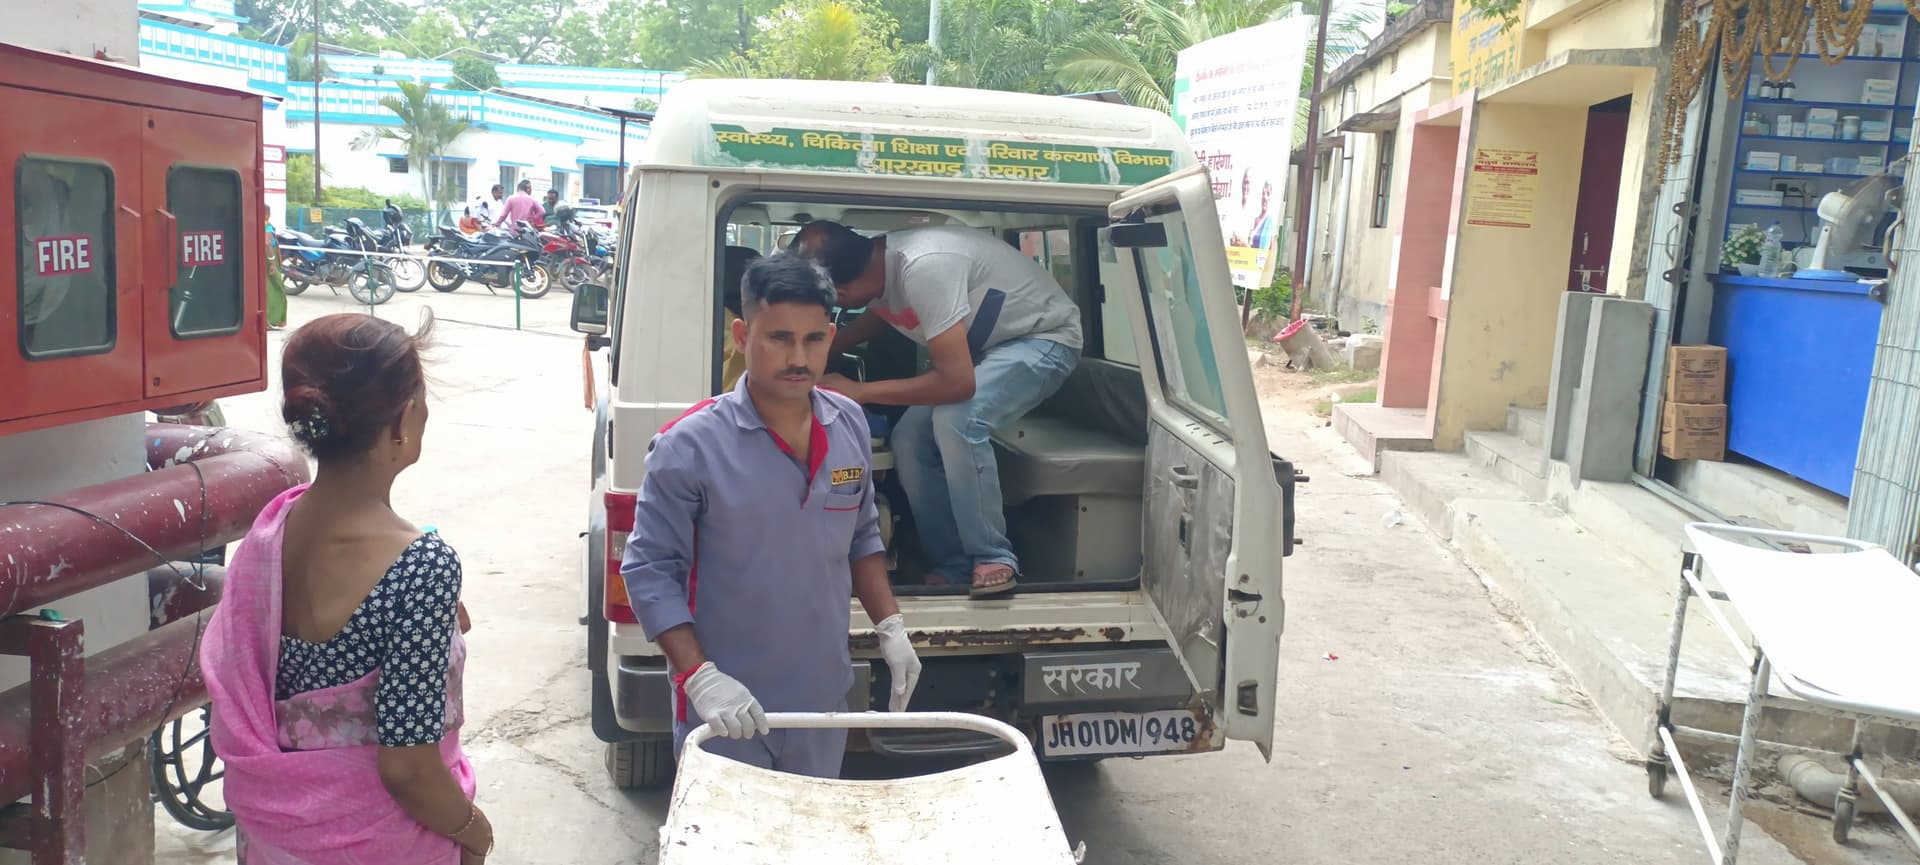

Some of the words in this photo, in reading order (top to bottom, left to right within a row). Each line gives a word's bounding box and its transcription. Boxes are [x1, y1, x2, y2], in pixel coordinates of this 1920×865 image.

[891, 137, 940, 156] शिक्षा
[944, 144, 971, 158] एव
[1113, 149, 1171, 167] विभाग
[38, 238, 90, 273] FIRE
[183, 234, 223, 263] FIRE
[1041, 661, 1143, 696] सरकार
